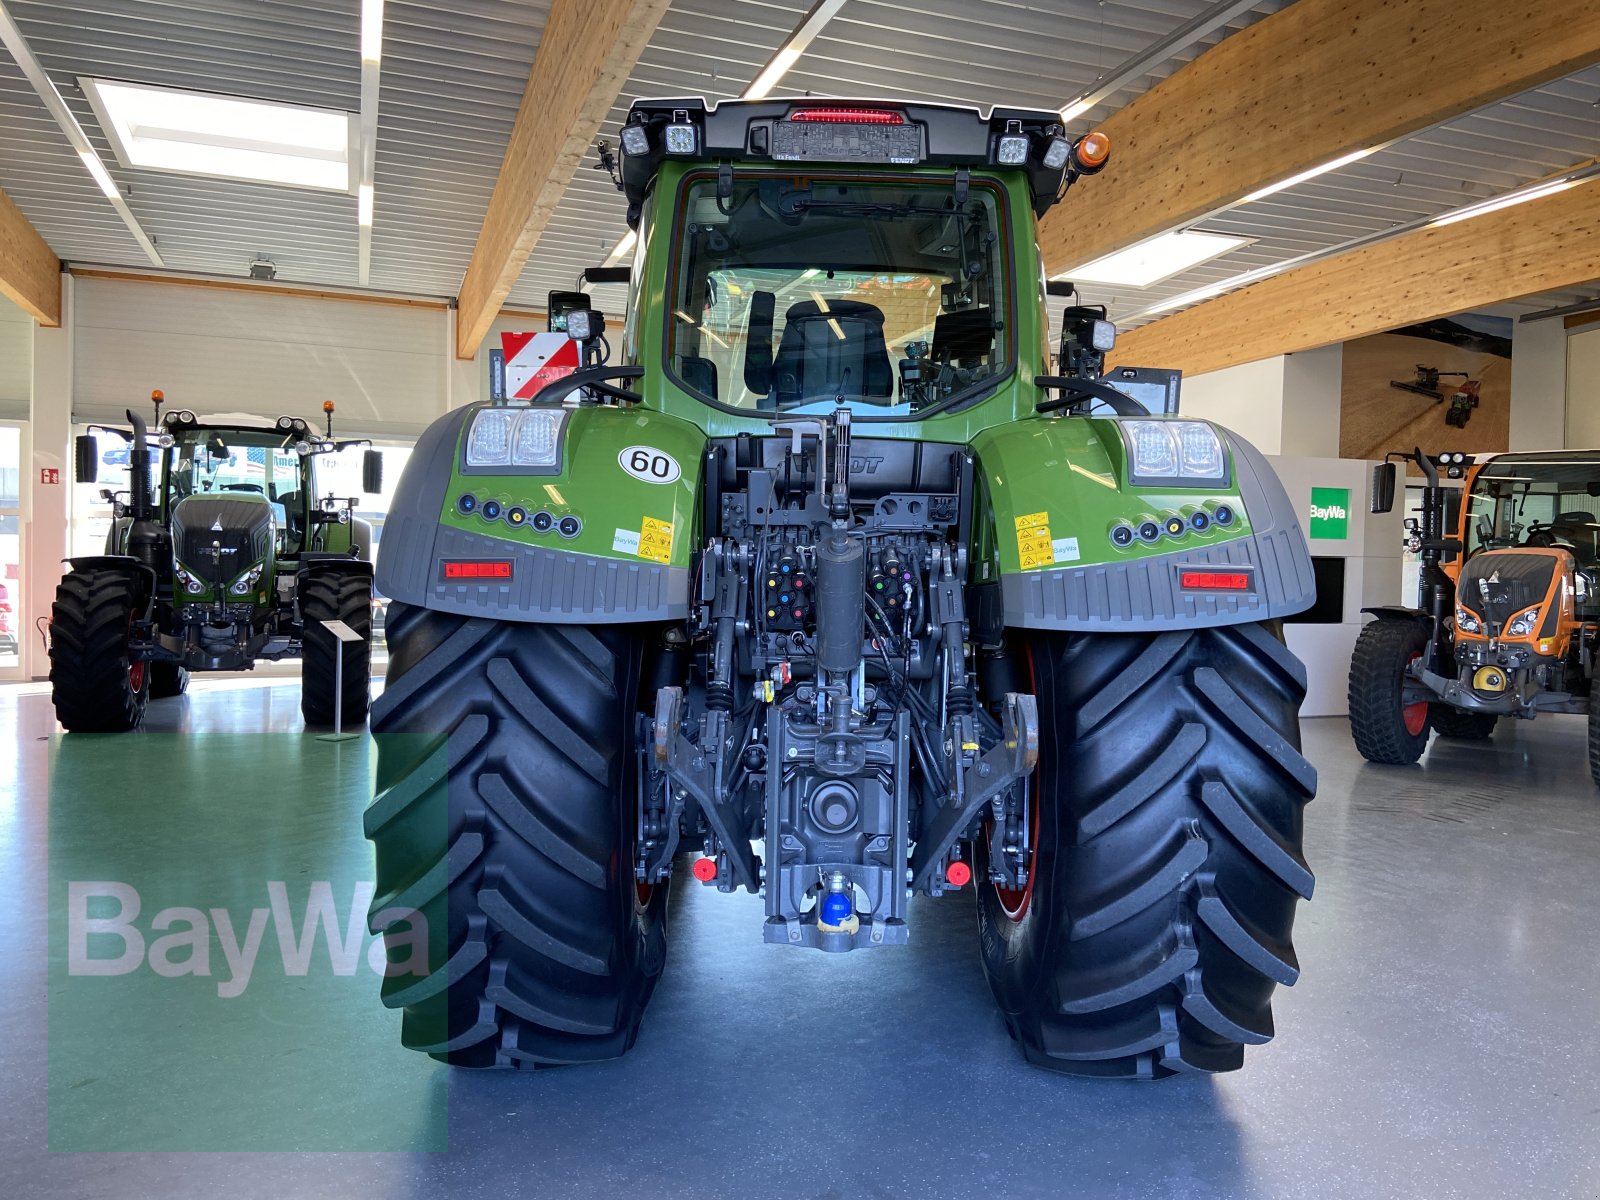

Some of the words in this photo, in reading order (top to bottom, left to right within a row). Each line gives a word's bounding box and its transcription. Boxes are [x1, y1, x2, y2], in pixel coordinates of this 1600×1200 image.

[630, 450, 670, 478] 60
[1310, 504, 1346, 521] BayWa
[613, 535, 638, 546] BayWa
[1053, 545, 1077, 554] BayWa
